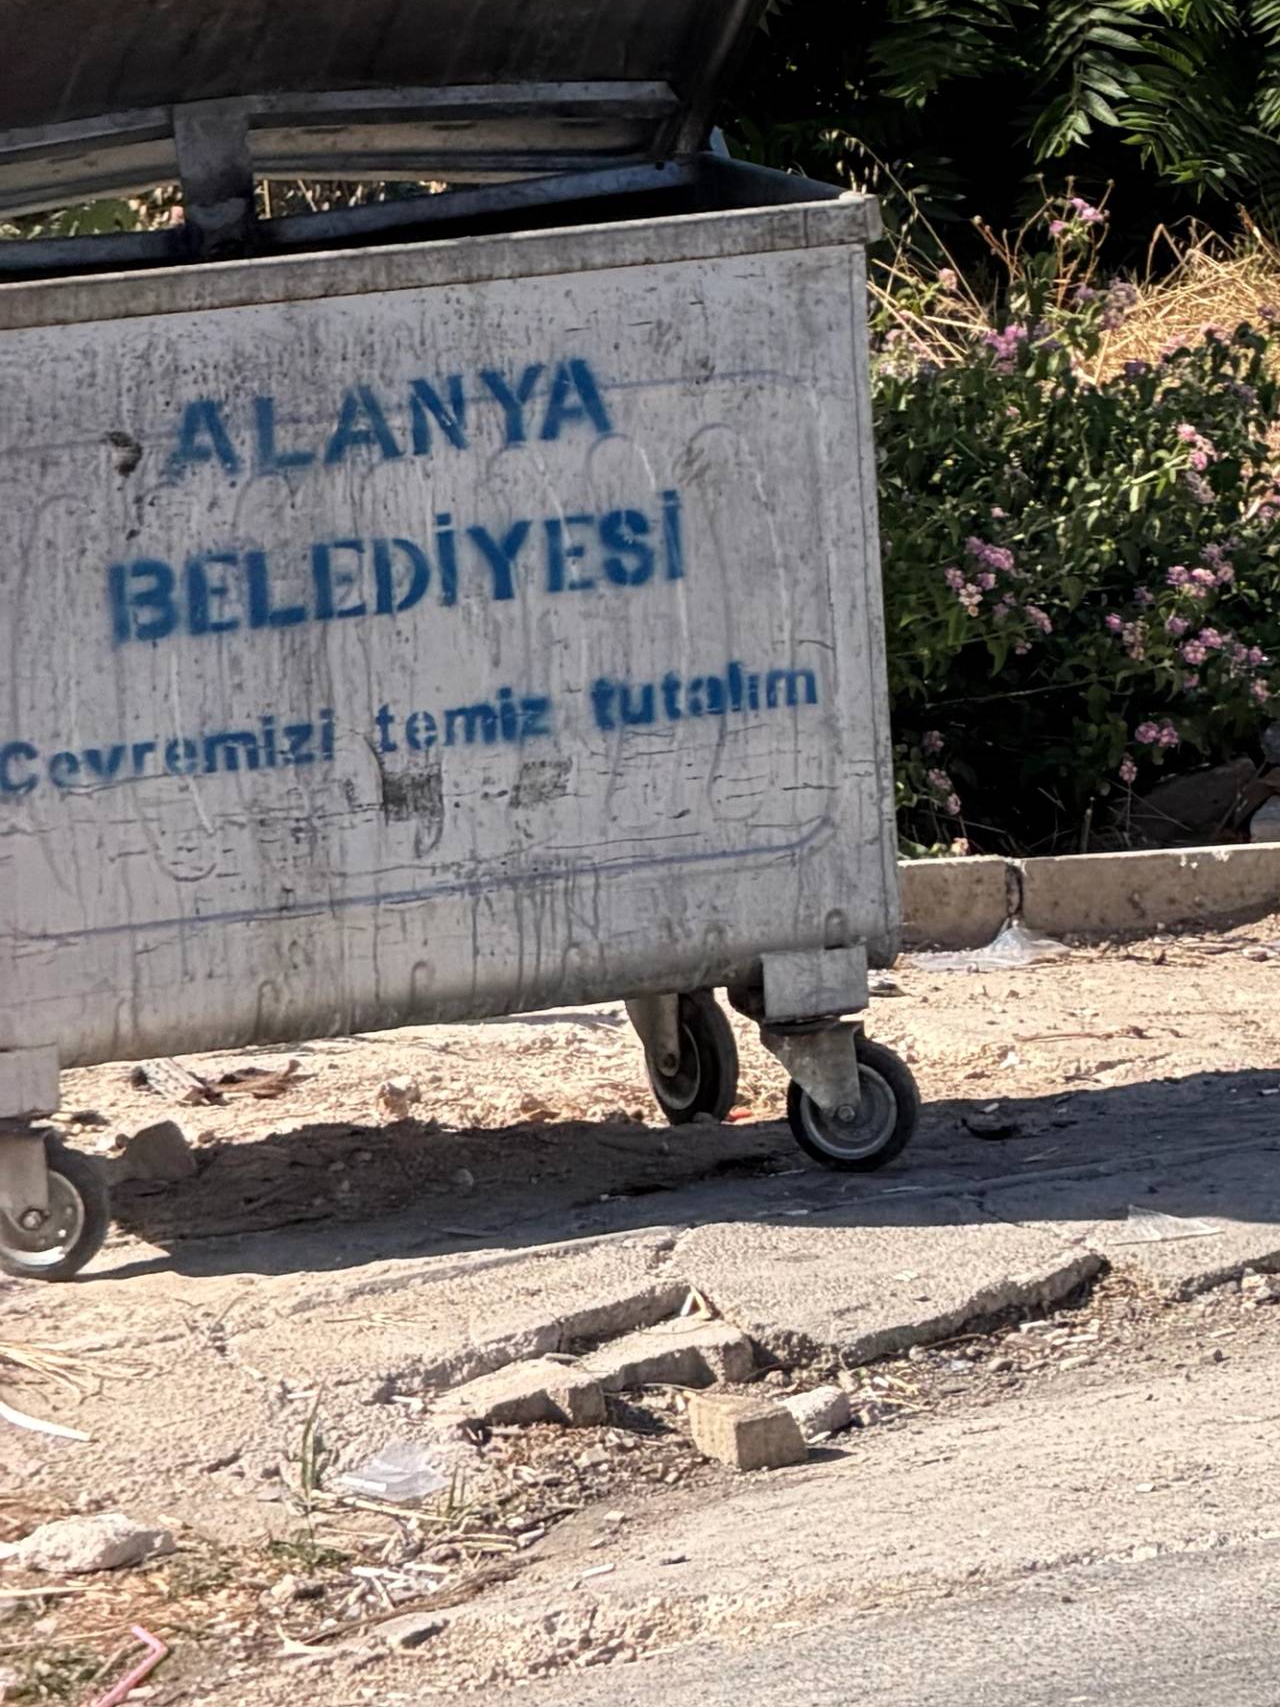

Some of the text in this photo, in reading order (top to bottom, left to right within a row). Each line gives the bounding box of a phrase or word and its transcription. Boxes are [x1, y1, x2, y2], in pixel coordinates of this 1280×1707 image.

[168, 358, 612, 477] ALANYA
[108, 489, 684, 644] BELEDİYESİ
[374, 686, 550, 754] temiz
[590, 660, 818, 730] tutalım
